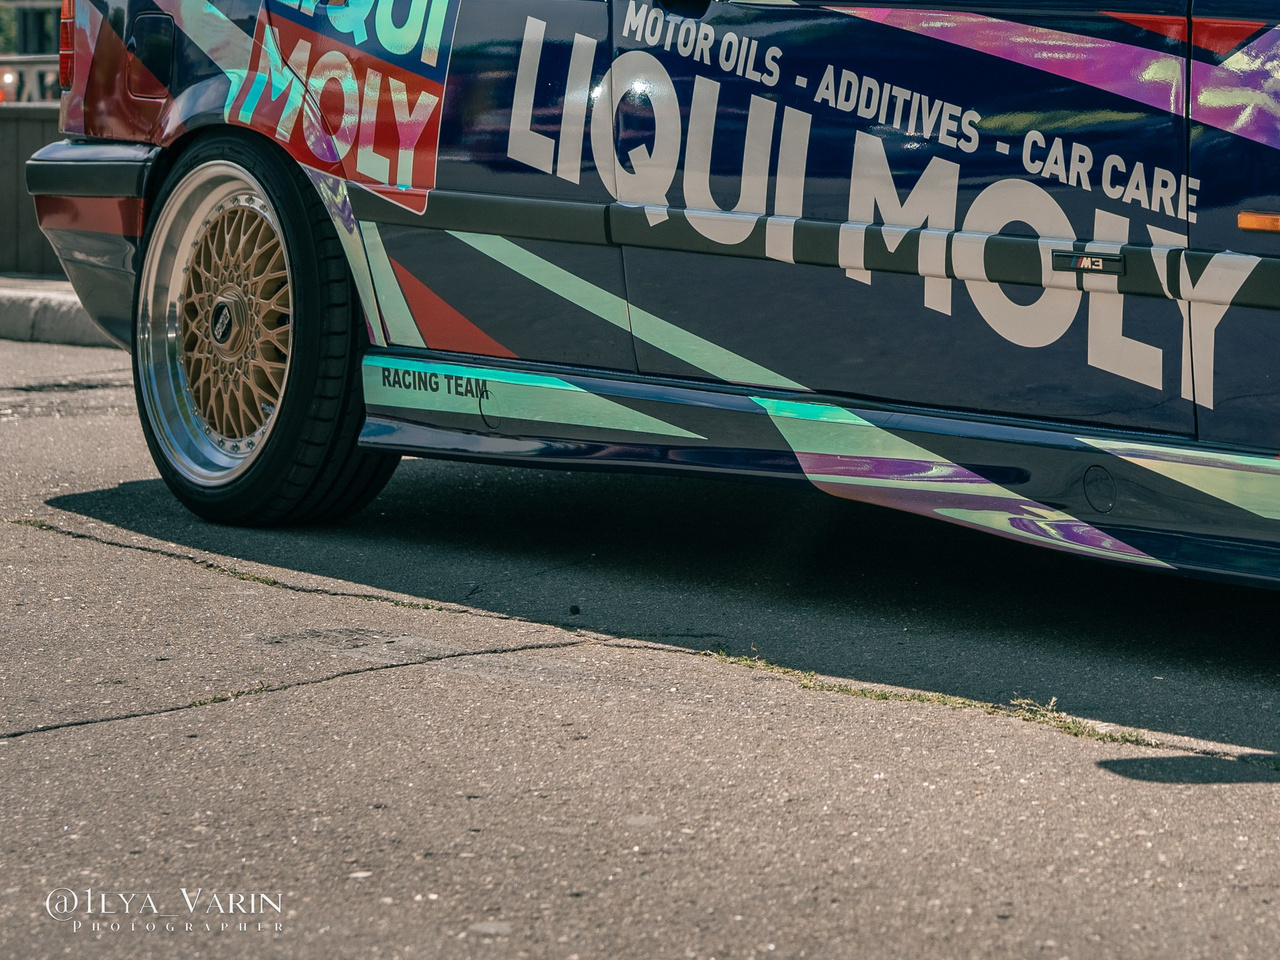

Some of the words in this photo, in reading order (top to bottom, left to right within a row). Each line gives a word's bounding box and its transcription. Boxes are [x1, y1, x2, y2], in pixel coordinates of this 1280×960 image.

[238, 24, 439, 189] MOLY
[622, 0, 715, 65] MOTOR
[719, 31, 783, 87] OILS
[814, 65, 981, 153] ADDITIVES
[1022, 129, 1093, 191] CAR
[1102, 154, 1200, 224] CARE
[507, 15, 811, 264] LIQUI
[839, 129, 1262, 410] MOLY
[381, 367, 439, 393] RACING
[444, 374, 489, 400] TEAM
